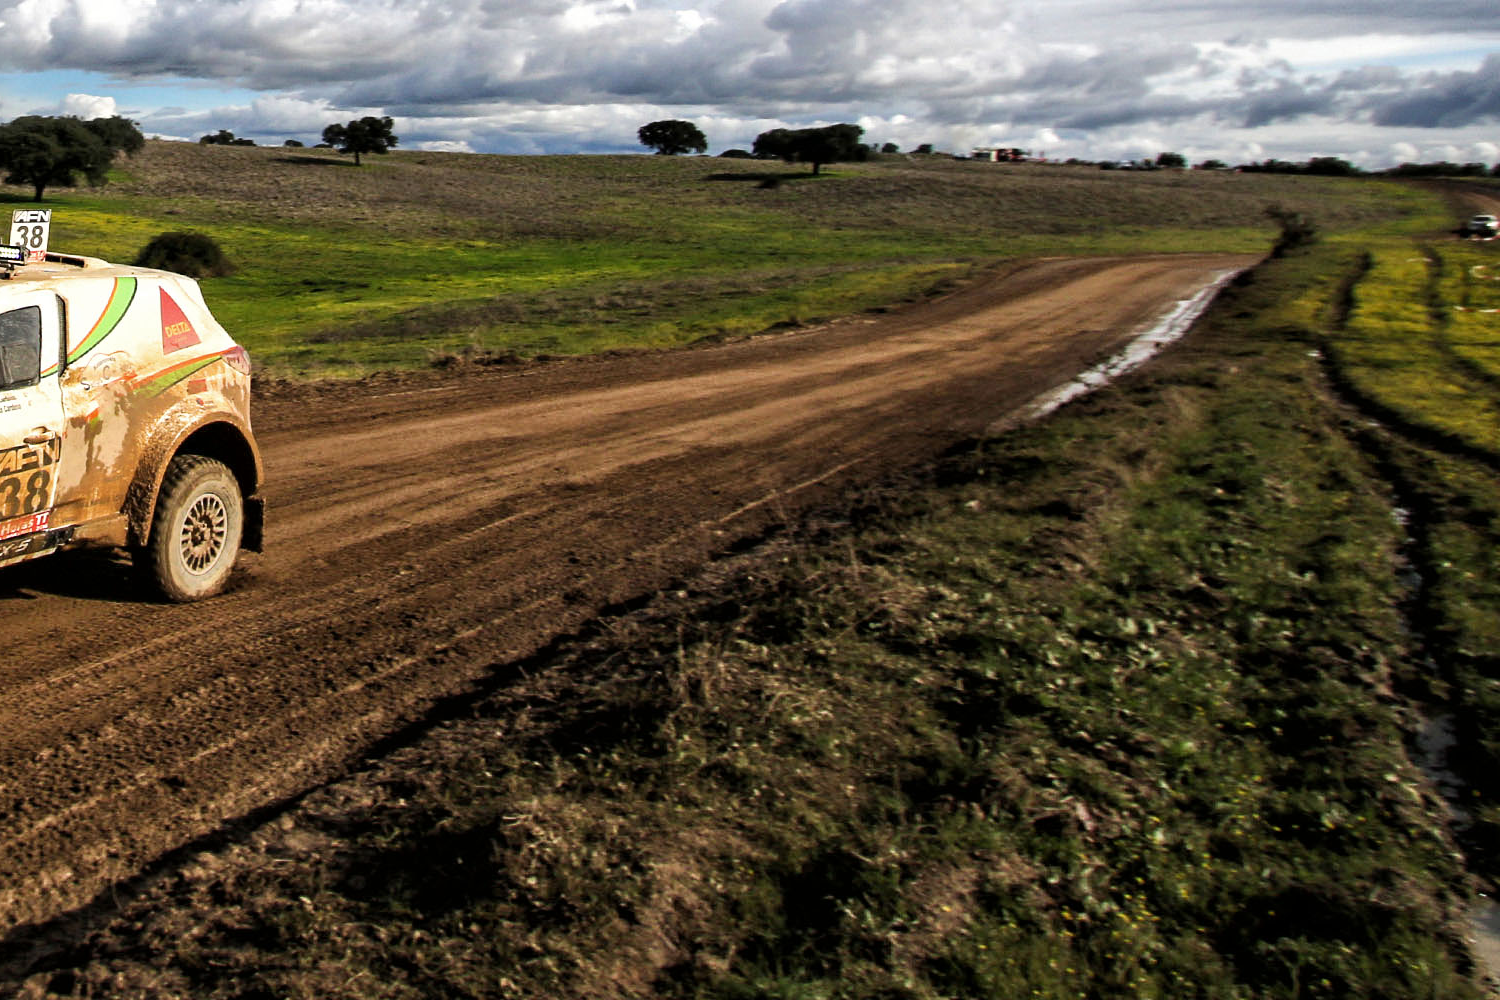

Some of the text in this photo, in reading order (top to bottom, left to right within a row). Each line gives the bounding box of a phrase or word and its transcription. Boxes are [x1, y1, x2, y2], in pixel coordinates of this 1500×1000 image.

[16, 210, 49, 222] AFN
[16, 225, 44, 249] 38
[164, 321, 191, 338] DELTA
[0, 519, 34, 537] Horas
[35, 512, 49, 525] TT
